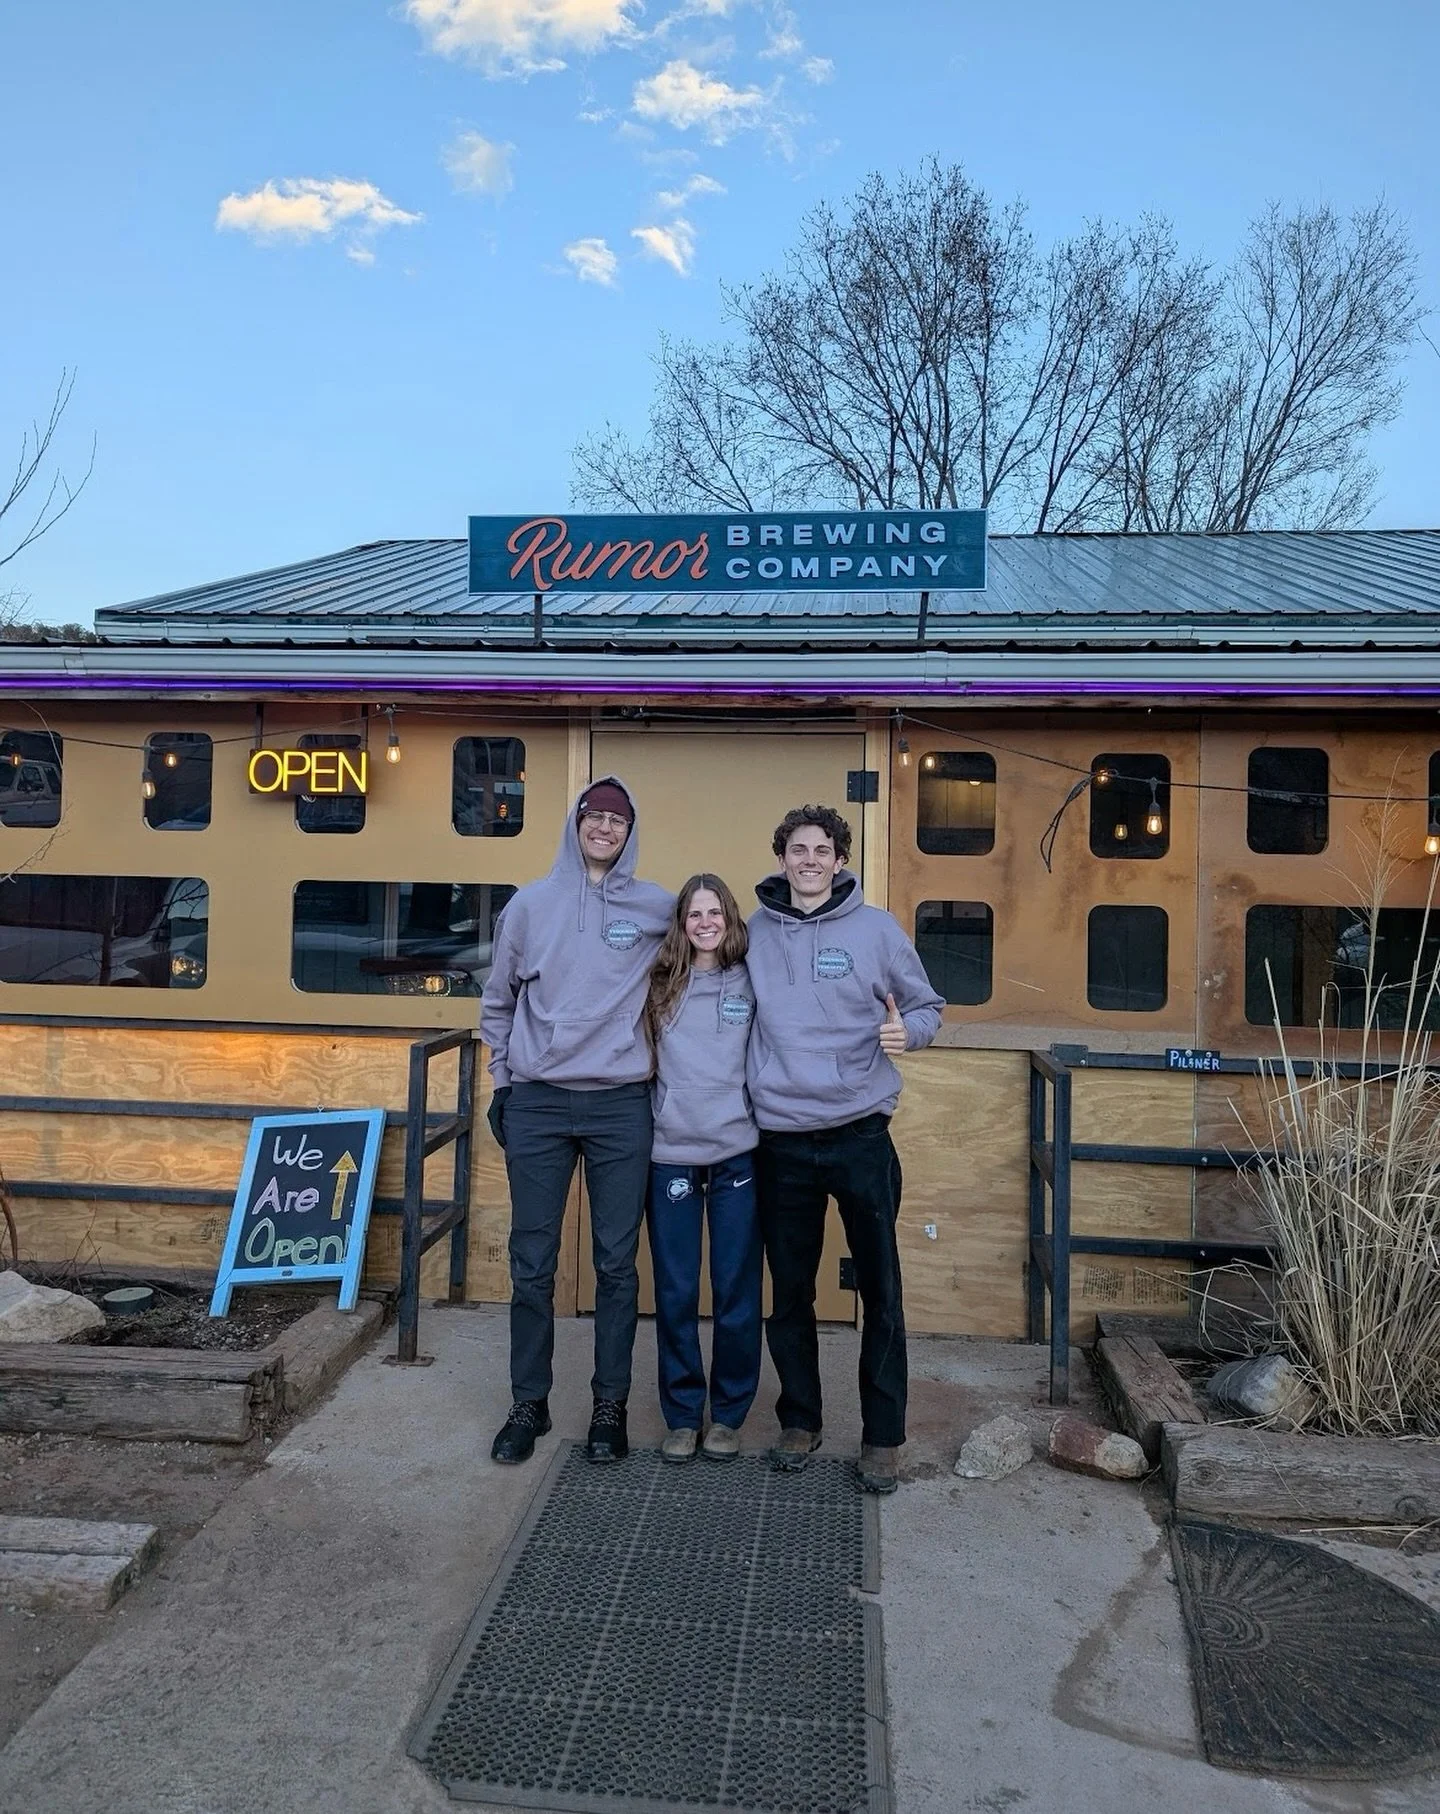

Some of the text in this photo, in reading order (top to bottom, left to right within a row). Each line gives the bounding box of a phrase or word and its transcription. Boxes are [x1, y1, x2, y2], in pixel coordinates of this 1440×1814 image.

[726, 521, 946, 546] BREWING
[507, 517, 709, 591] Rumor
[725, 555, 948, 579] COMPANY
[249, 750, 367, 793] OPEN
[1170, 1050, 1220, 1070] PILSNER
[272, 1134, 323, 1170] We
[252, 1176, 320, 1215] Are
[244, 1217, 352, 1268] Open!
